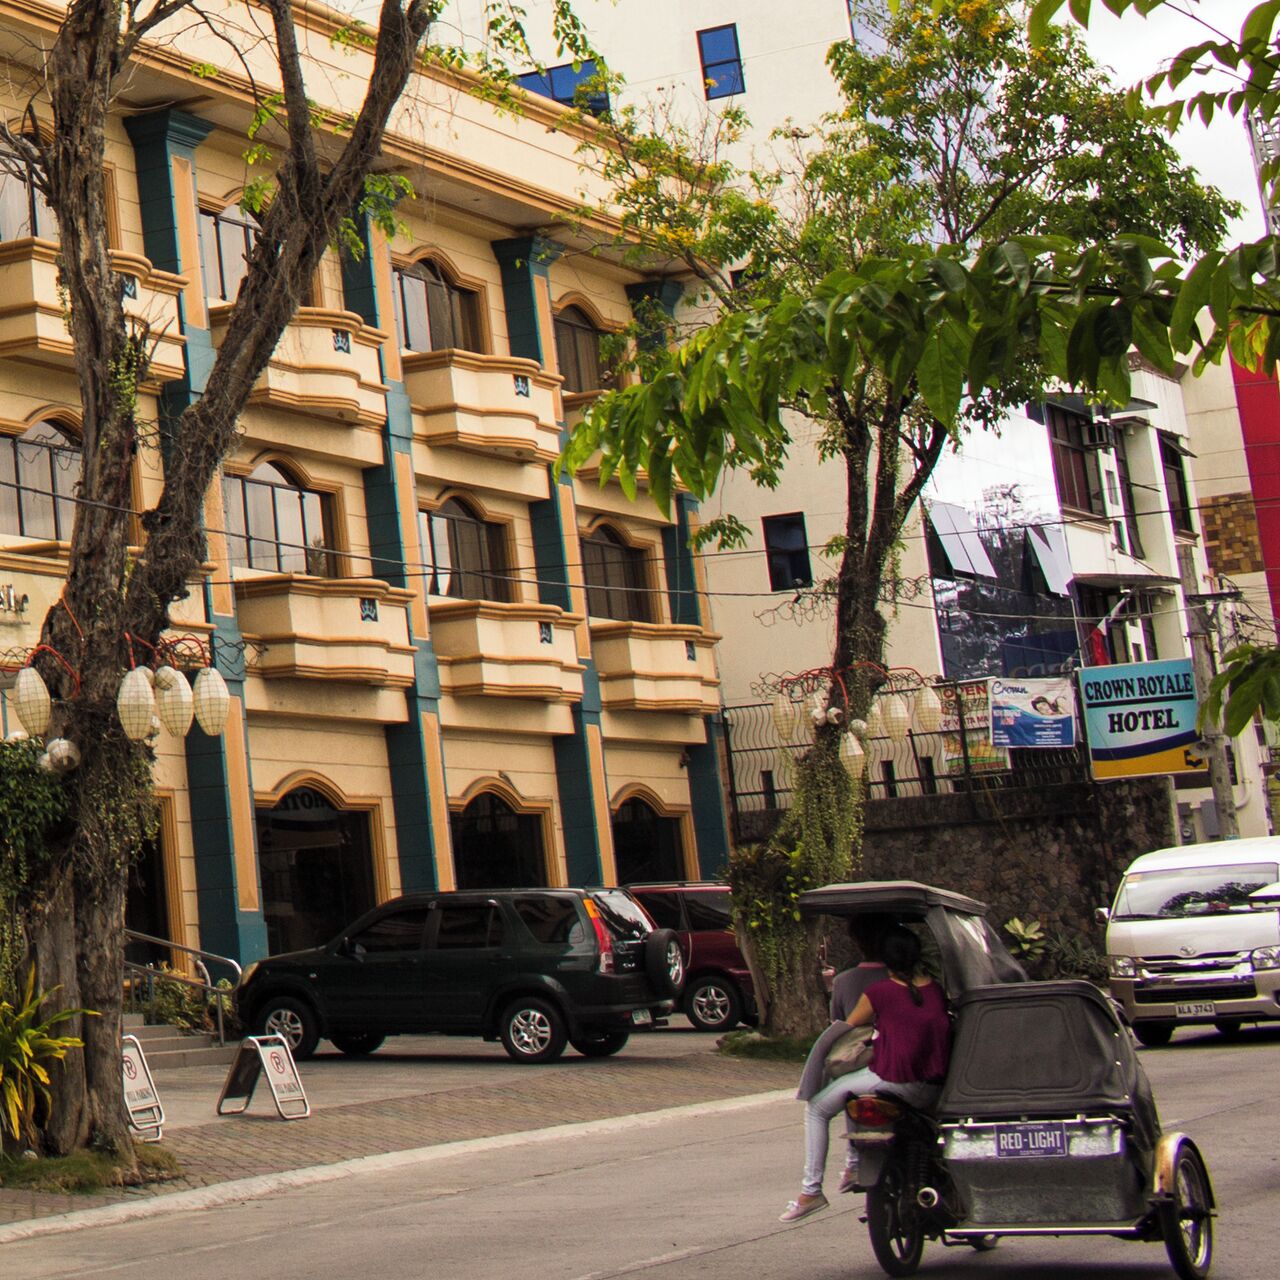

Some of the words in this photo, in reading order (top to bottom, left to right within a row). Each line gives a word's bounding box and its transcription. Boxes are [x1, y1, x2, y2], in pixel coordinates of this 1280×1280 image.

[991, 680, 1029, 695] Crown
[1084, 678, 1136, 701] CROWN
[1136, 673, 1194, 697] ROYALE
[1107, 708, 1180, 734] HOTEL
